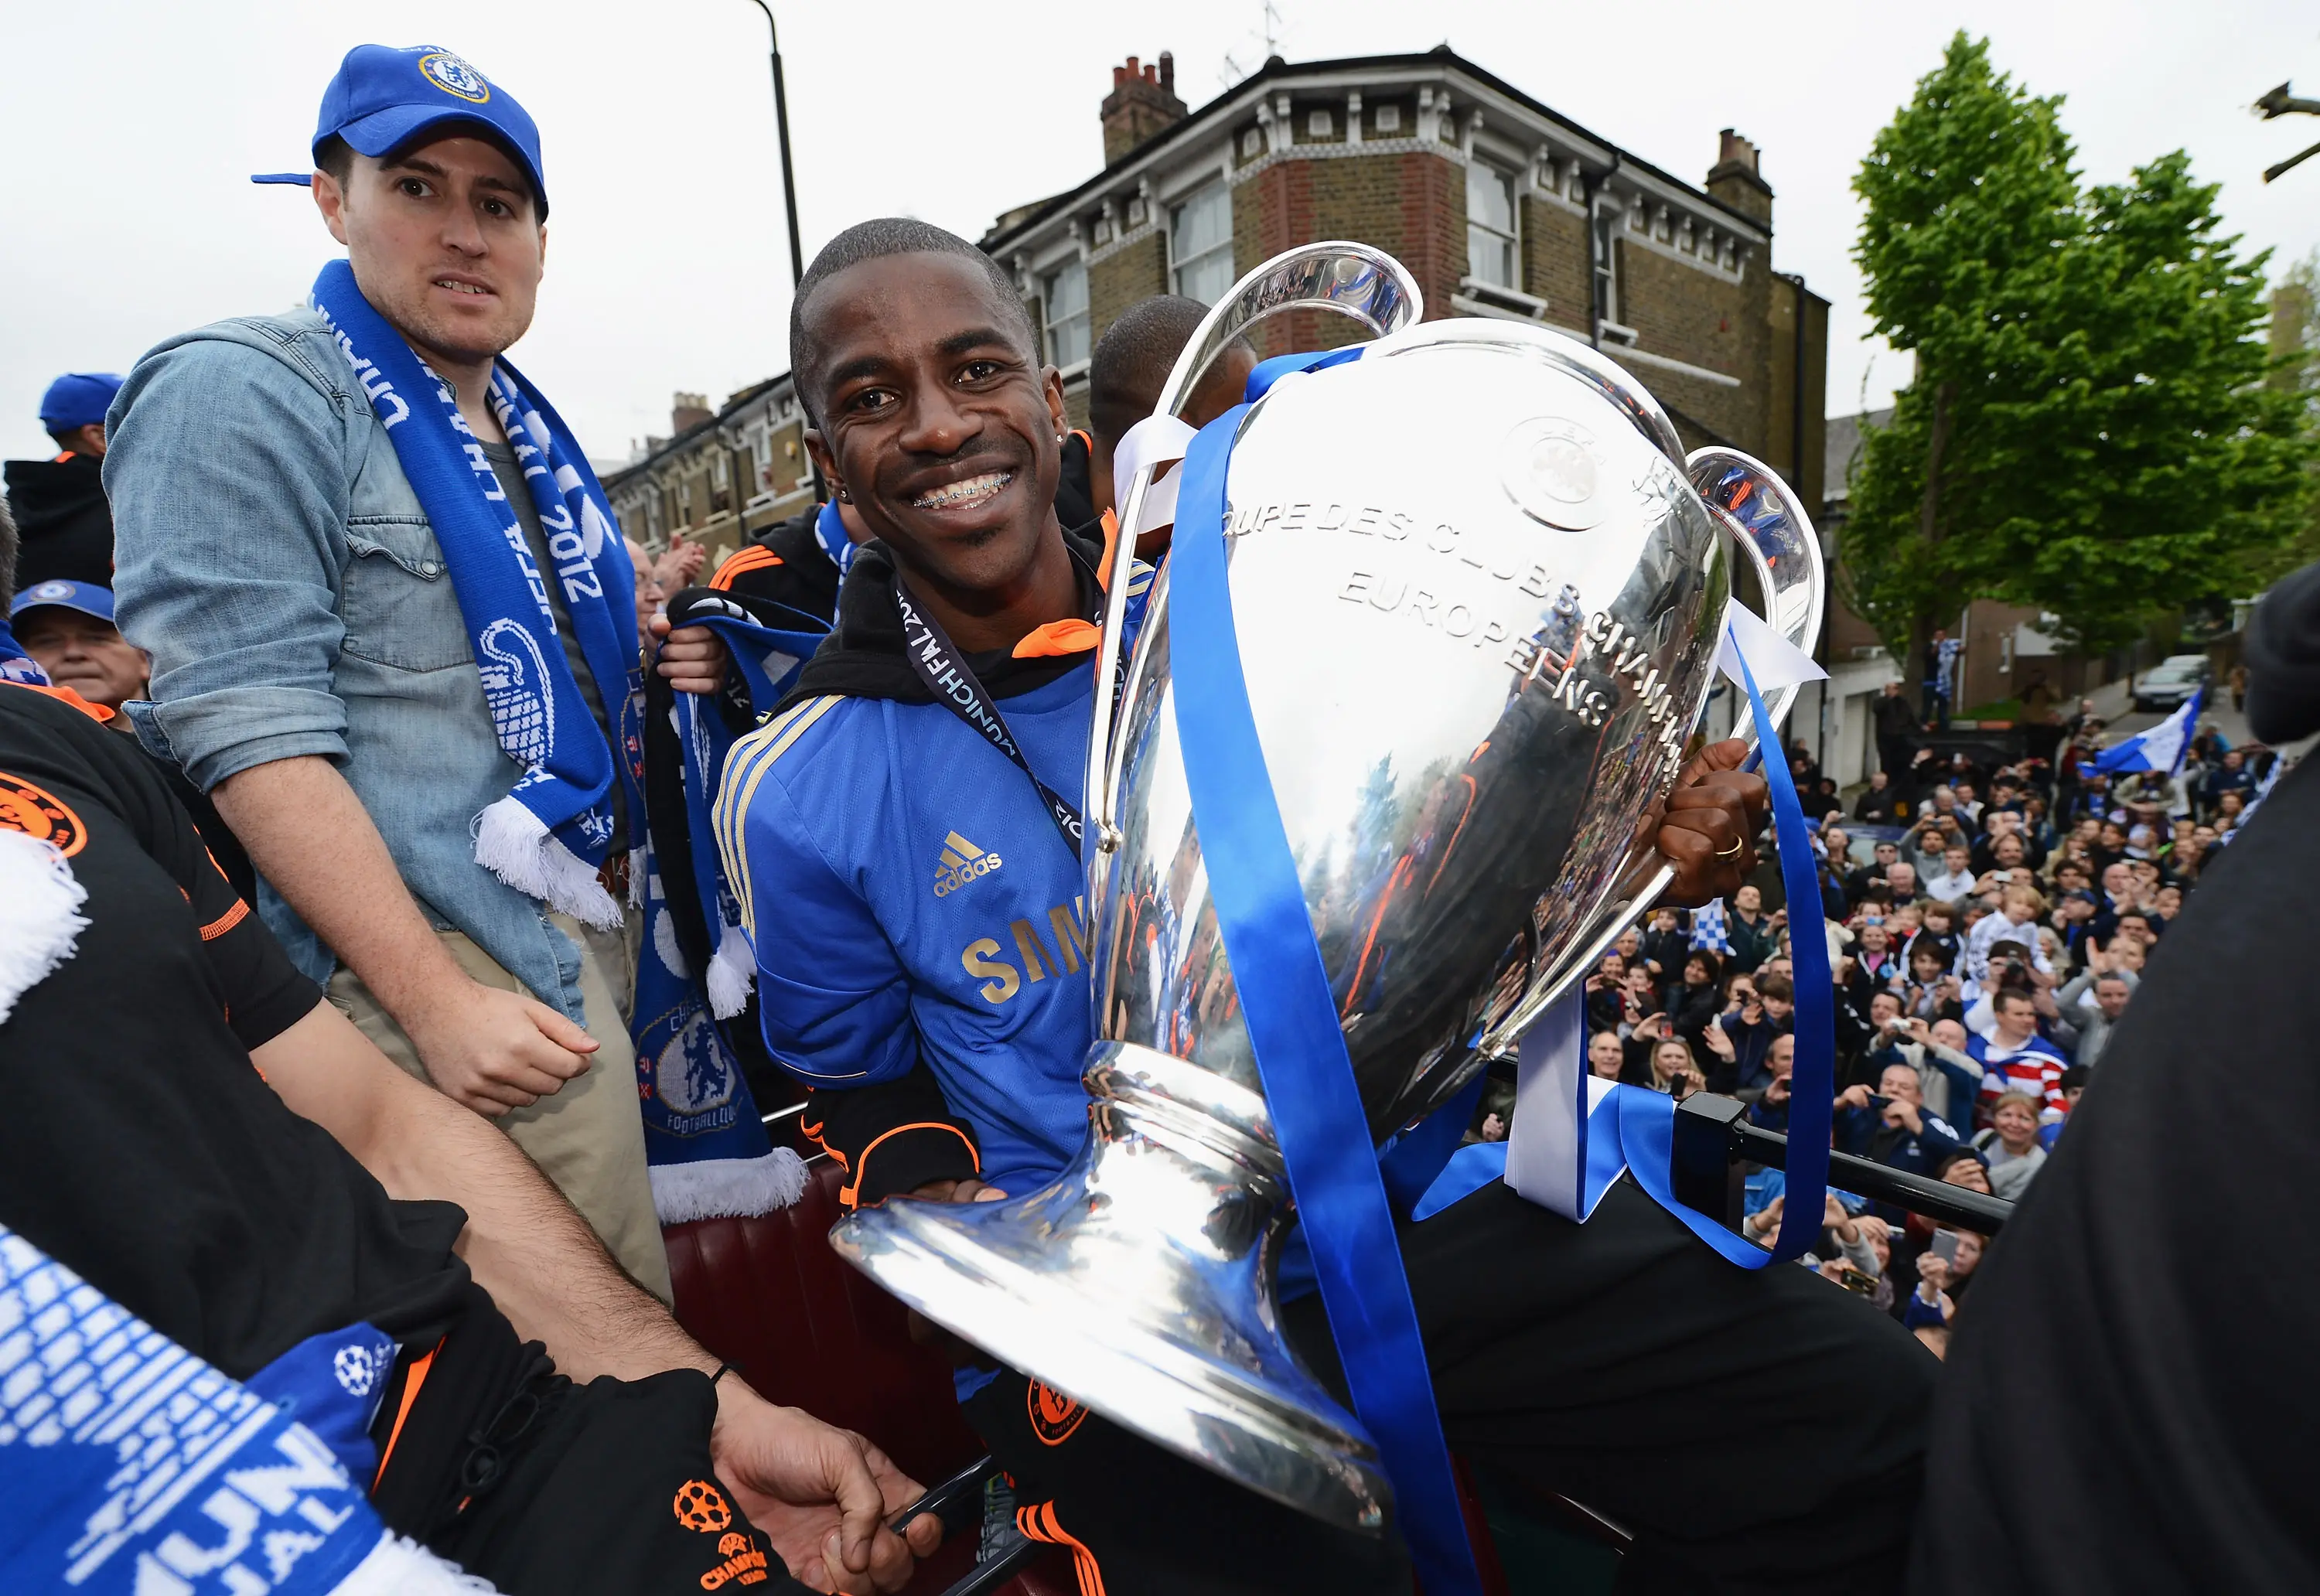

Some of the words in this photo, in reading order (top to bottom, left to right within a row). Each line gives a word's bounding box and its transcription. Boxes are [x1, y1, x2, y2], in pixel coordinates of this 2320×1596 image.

[539, 504, 603, 603] 2012
[1317, 504, 1414, 541] DES
[1428, 523, 1581, 617] CLUBS
[937, 667, 1016, 756] MUNICH
[933, 852, 1003, 898] adidas
[667, 1107, 718, 1135] FOOTBALL
